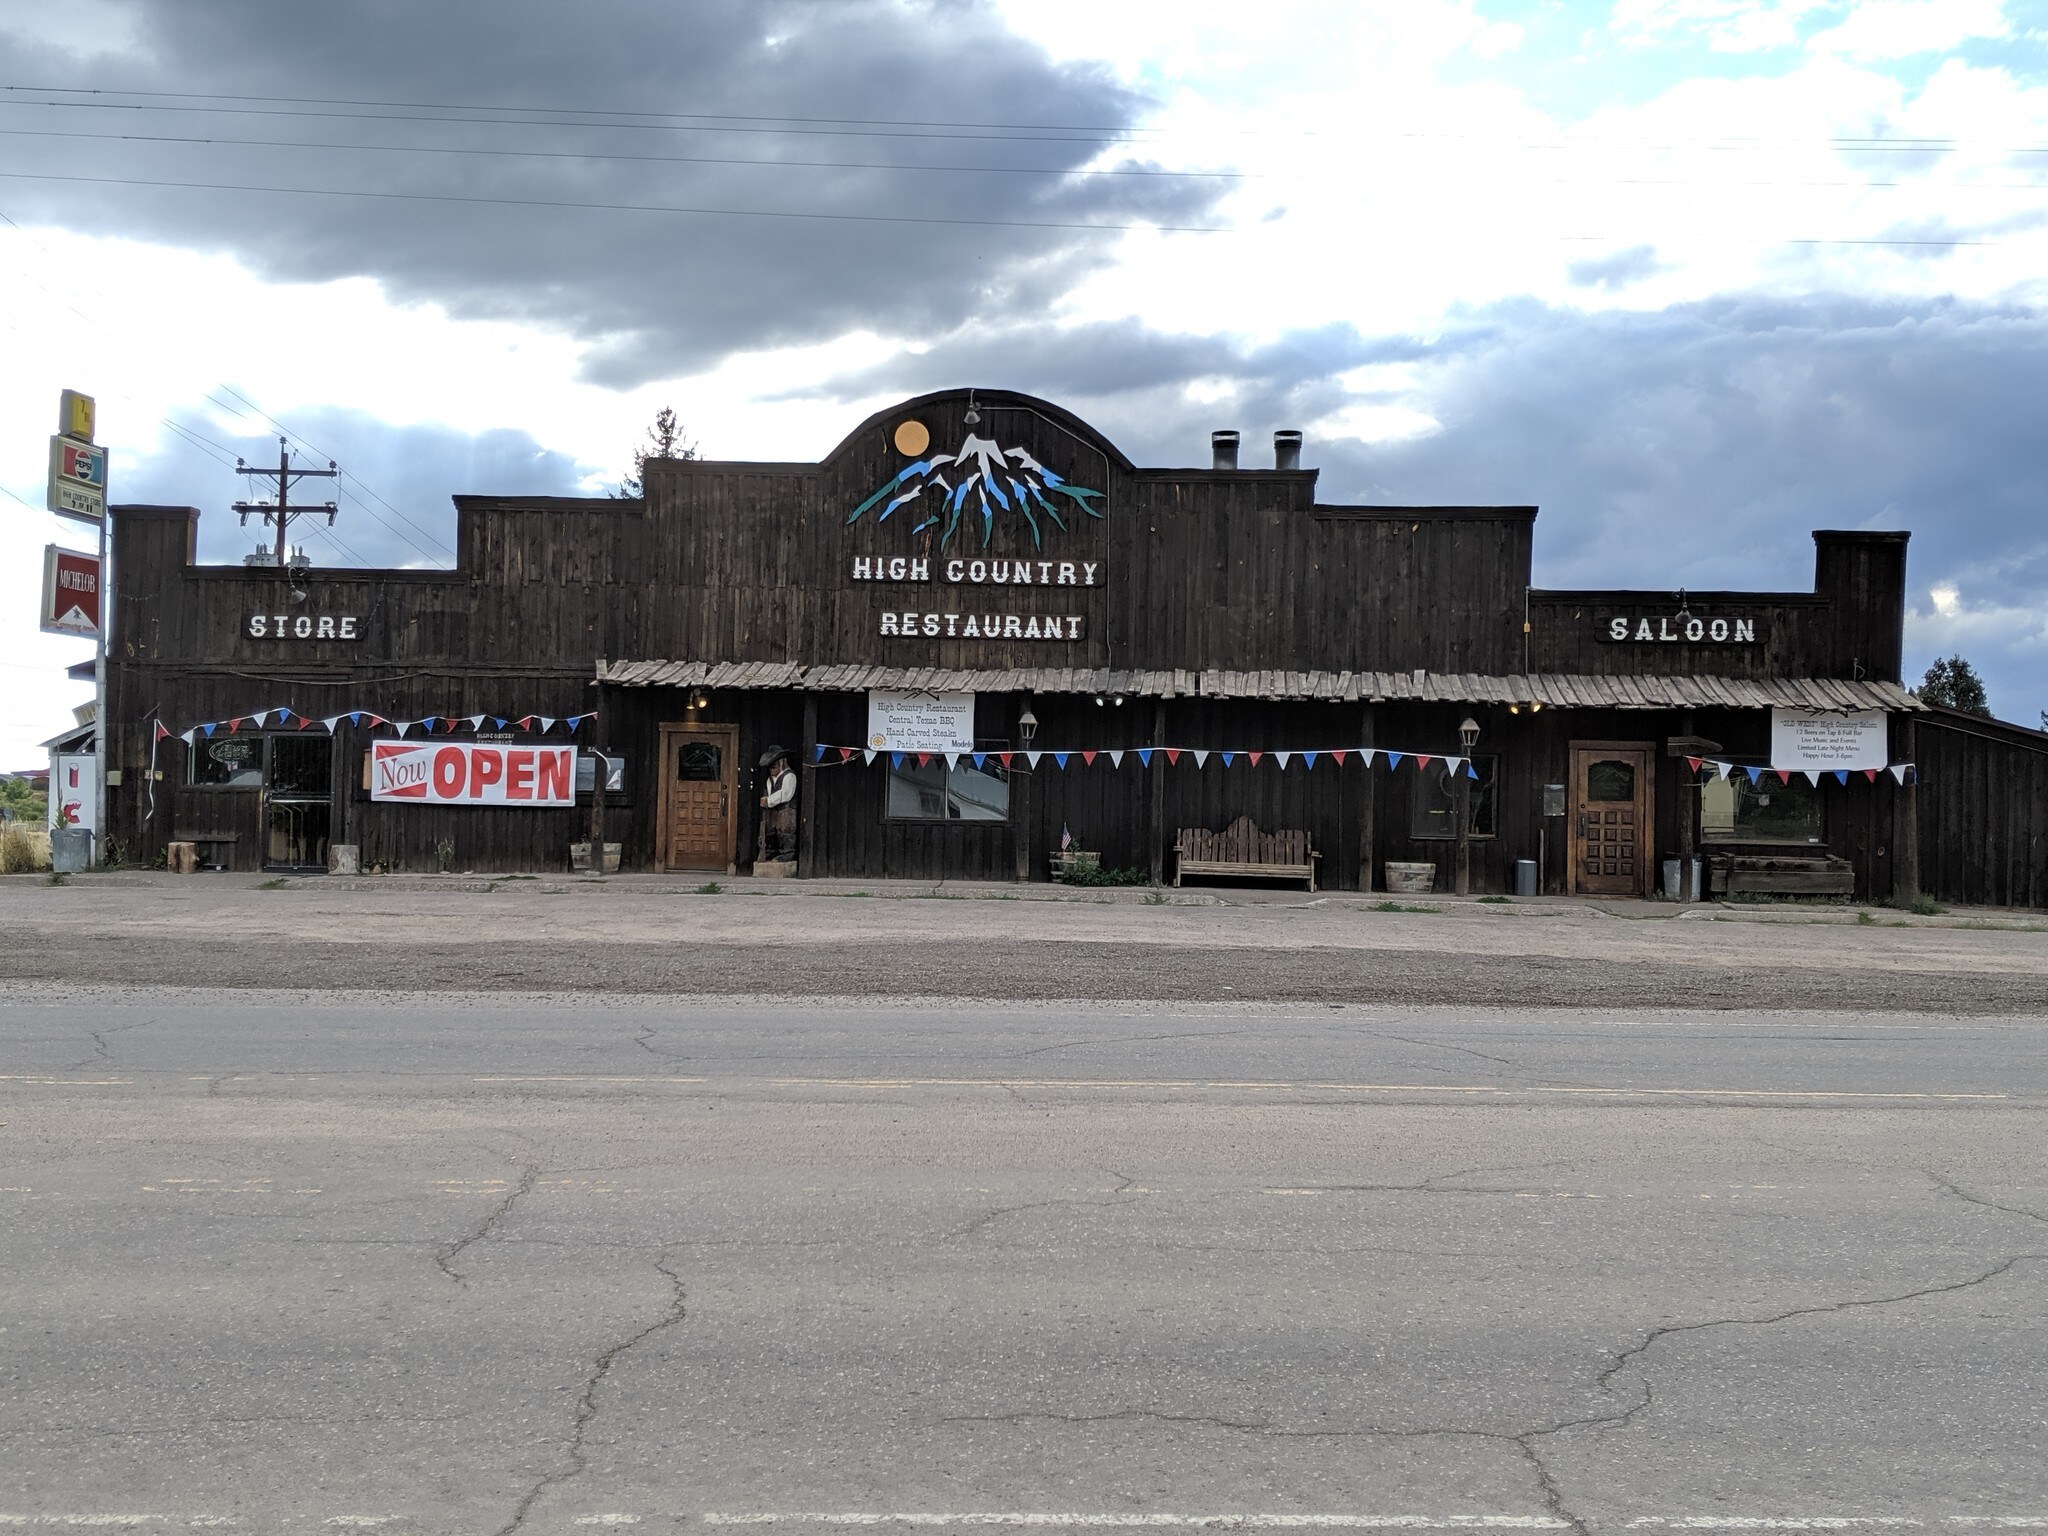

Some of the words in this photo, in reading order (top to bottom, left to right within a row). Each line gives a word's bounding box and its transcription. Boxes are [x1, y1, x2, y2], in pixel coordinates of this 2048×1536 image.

[75, 459, 92, 471] PEPSI
[852, 557, 929, 581] HIGH
[947, 560, 1098, 585] COUNTRY
[59, 569, 95, 593] MICHELOB
[249, 615, 357, 639] STORE
[880, 613, 1082, 639] RESTAURANT
[1609, 618, 1755, 642] SALOON
[877, 702, 894, 713] High
[897, 703, 924, 714] Country
[926, 703, 967, 713] Restaurant
[888, 715, 913, 724] Central
[916, 716, 937, 724] Texas
[939, 716, 955, 726] BBQ
[1820, 720, 1834, 729] High
[1836, 721, 1858, 729] Country
[886, 727, 904, 736] Hand
[907, 728, 930, 737] Carved
[933, 729, 957, 738] Steaks
[896, 740, 915, 748] Patio
[917, 741, 943, 752] Seating
[433, 746, 573, 801] OPEN
